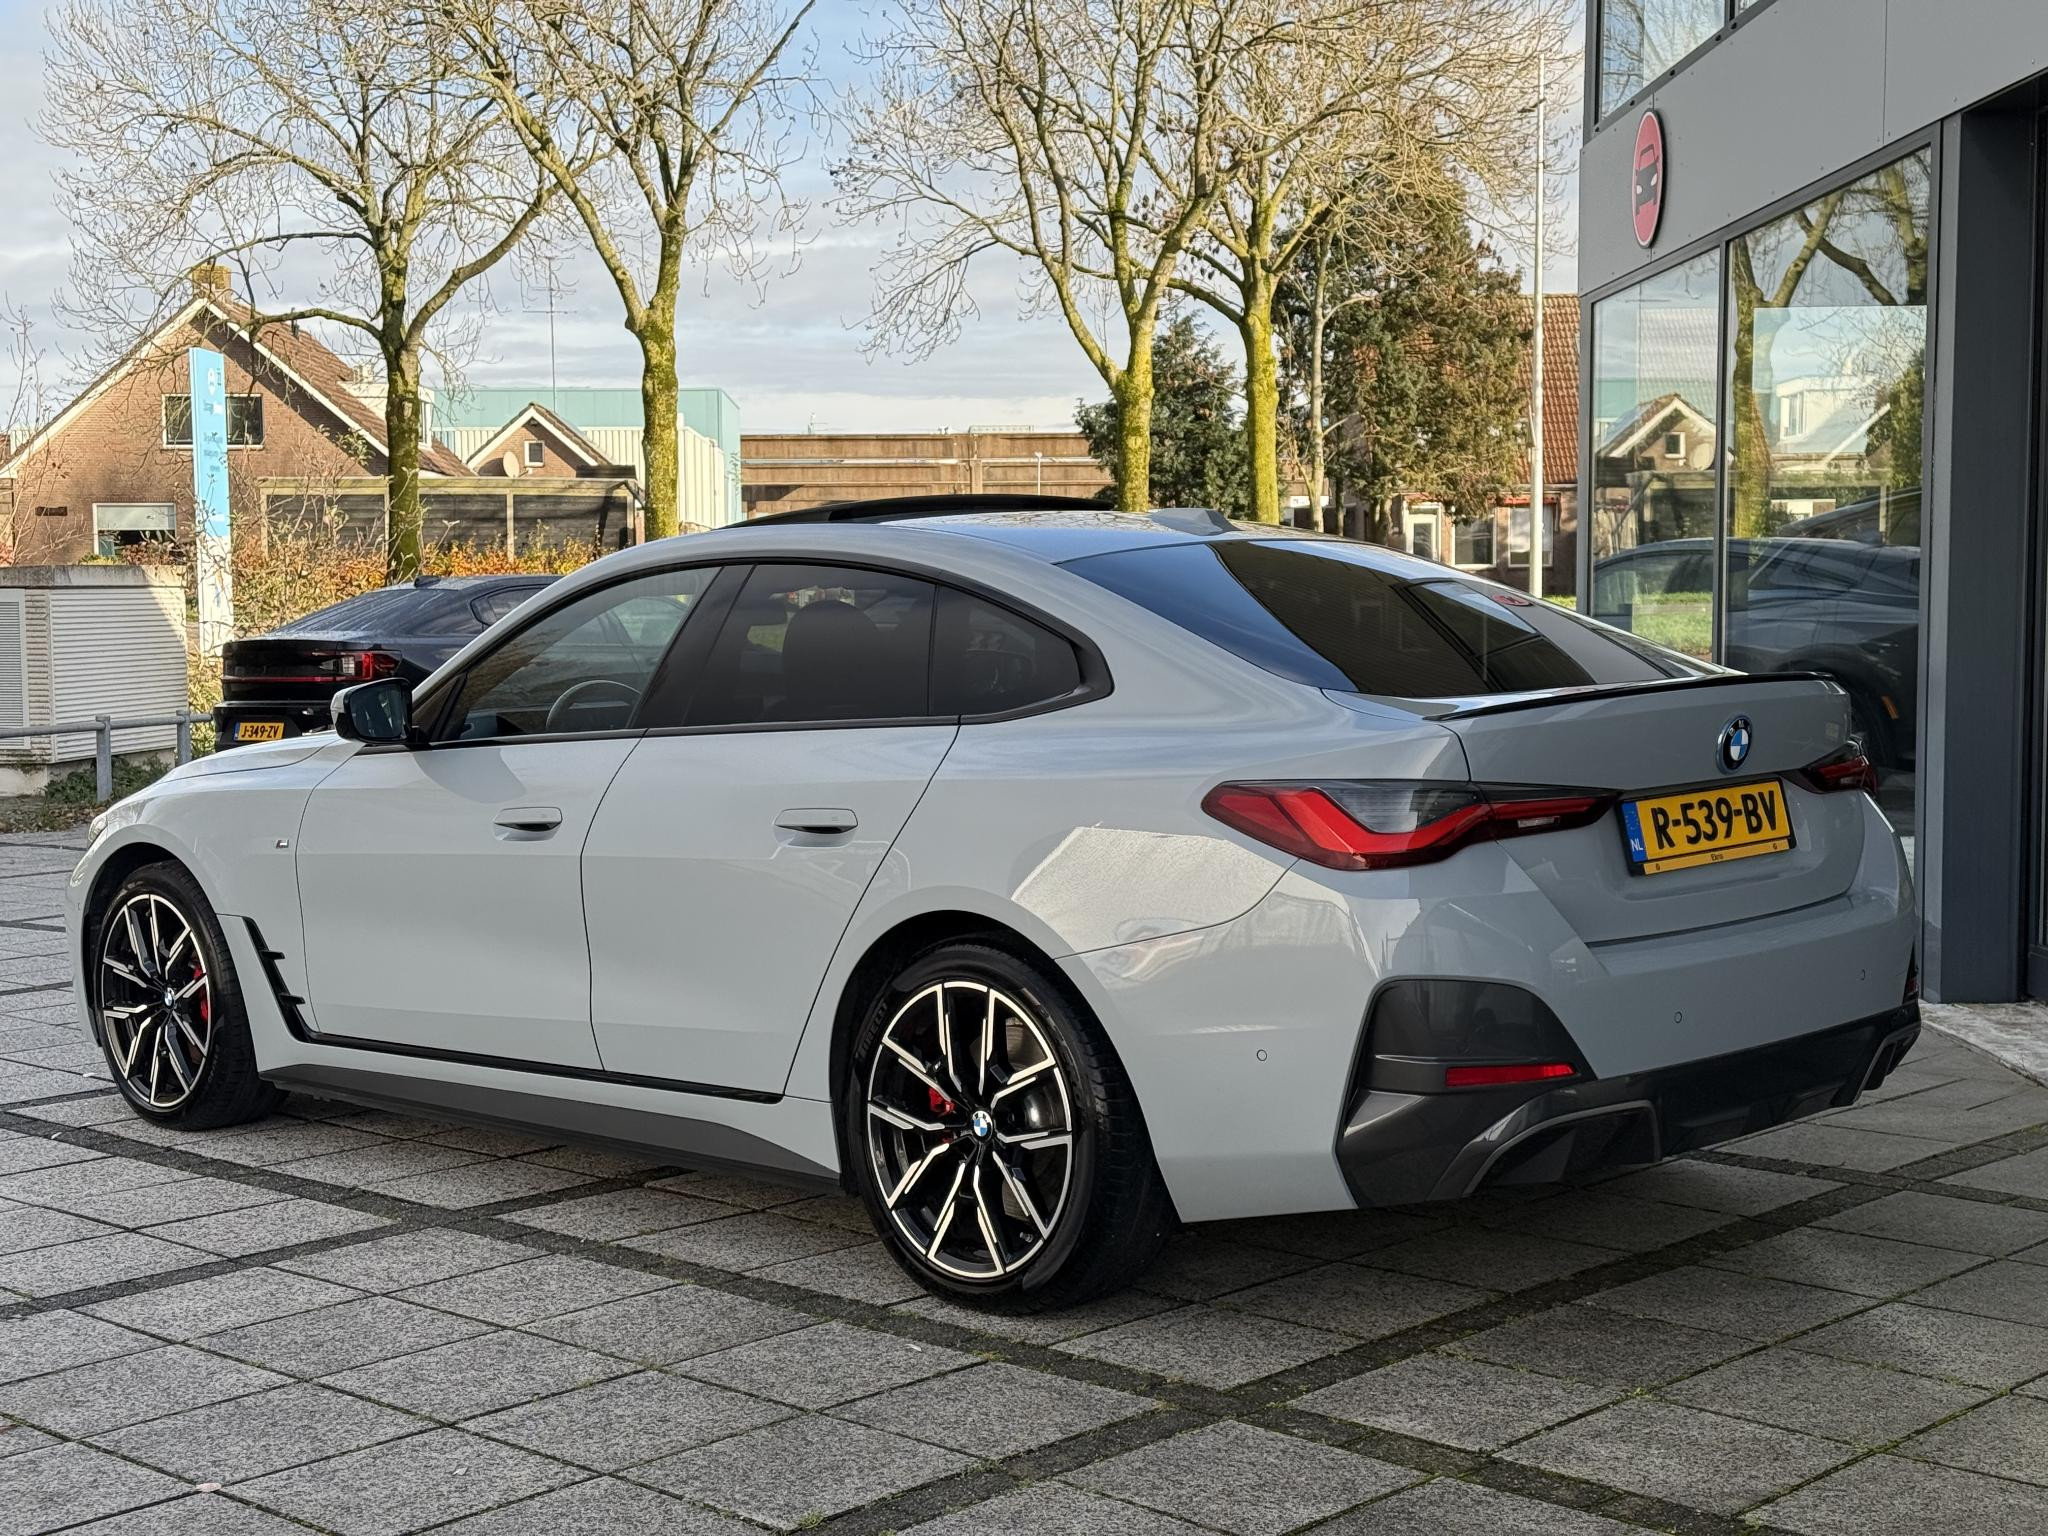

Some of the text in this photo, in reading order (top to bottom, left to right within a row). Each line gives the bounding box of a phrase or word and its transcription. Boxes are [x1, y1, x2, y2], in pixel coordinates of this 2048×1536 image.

[241, 725, 279, 738] J-349-ZV
[1651, 790, 1777, 850] R-539-BV
[1631, 838, 1644, 852] NL
